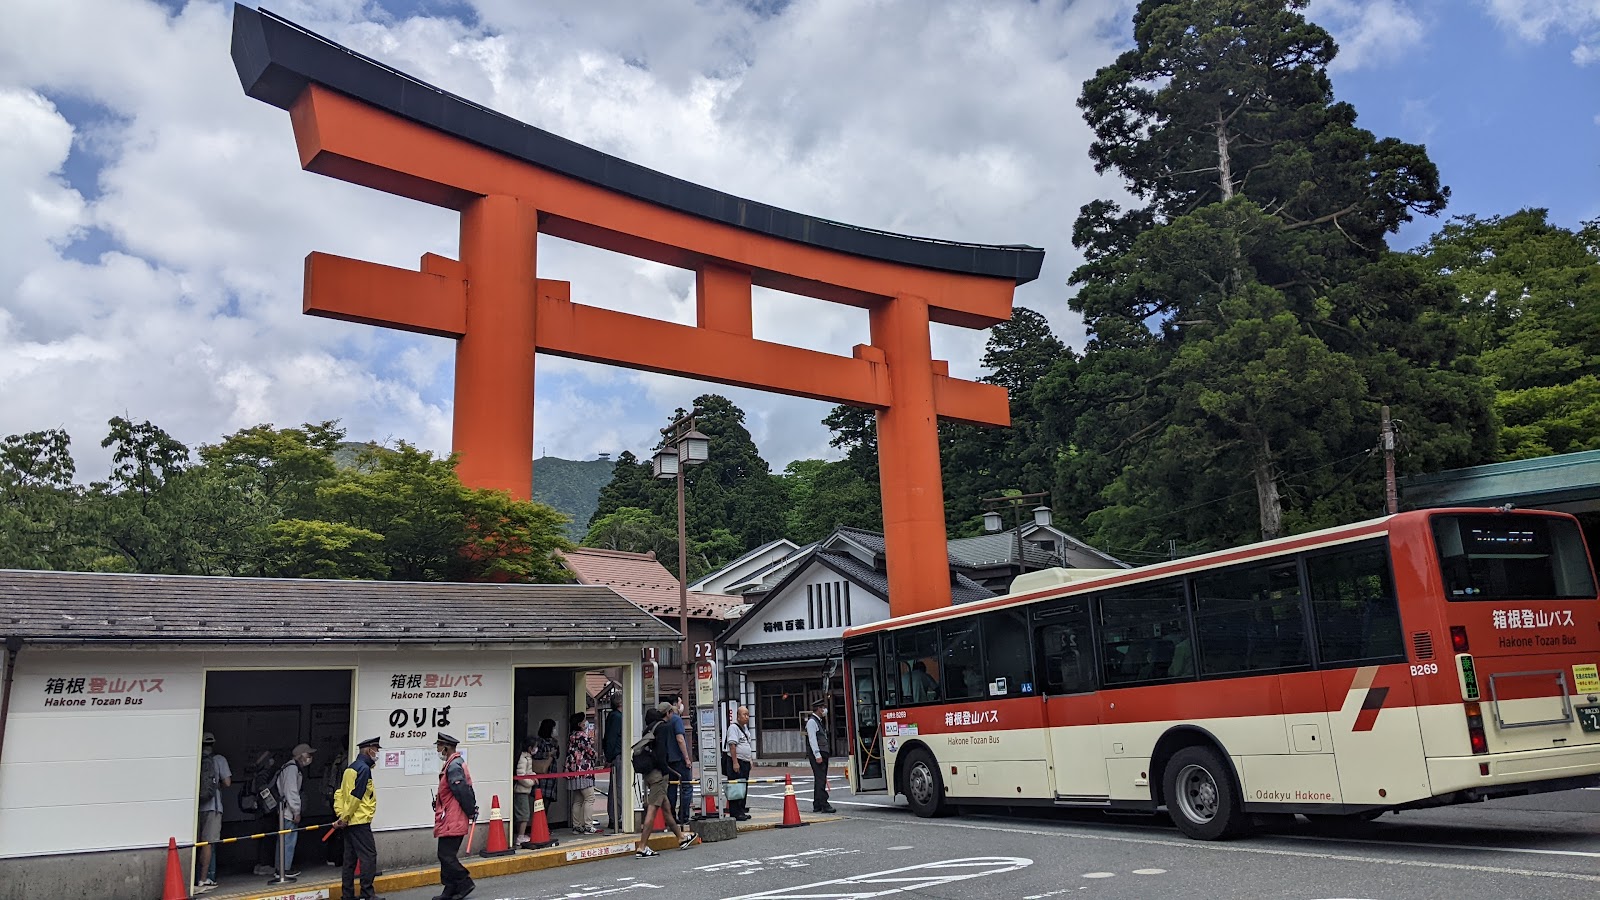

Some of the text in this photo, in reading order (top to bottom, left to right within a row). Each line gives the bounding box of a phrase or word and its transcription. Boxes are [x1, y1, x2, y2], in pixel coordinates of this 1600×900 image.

[1492, 609, 1575, 629] 箱根登山バス
[1499, 634, 1577, 648] Hakone Tozan Bus
[704, 643, 712, 657] 2
[1410, 663, 1438, 676] B269
[390, 673, 483, 689] 箱根登山バス
[1462, 657, 1477, 698] 乗降中
[44, 677, 164, 694] 箱根登山バス
[44, 696, 143, 707] Hakone Tozan Bus
[390, 690, 467, 699] Hakone Tozan Bus
[389, 705, 451, 728] のりば
[945, 710, 999, 726] 箱根登山バス
[389, 730, 427, 740] Bus Stop
[947, 735, 1000, 746] Hakone Tozan Bus
[1255, 789, 1331, 801] Odakyu Hakone
[580, 847, 609, 858] 足もと注意
